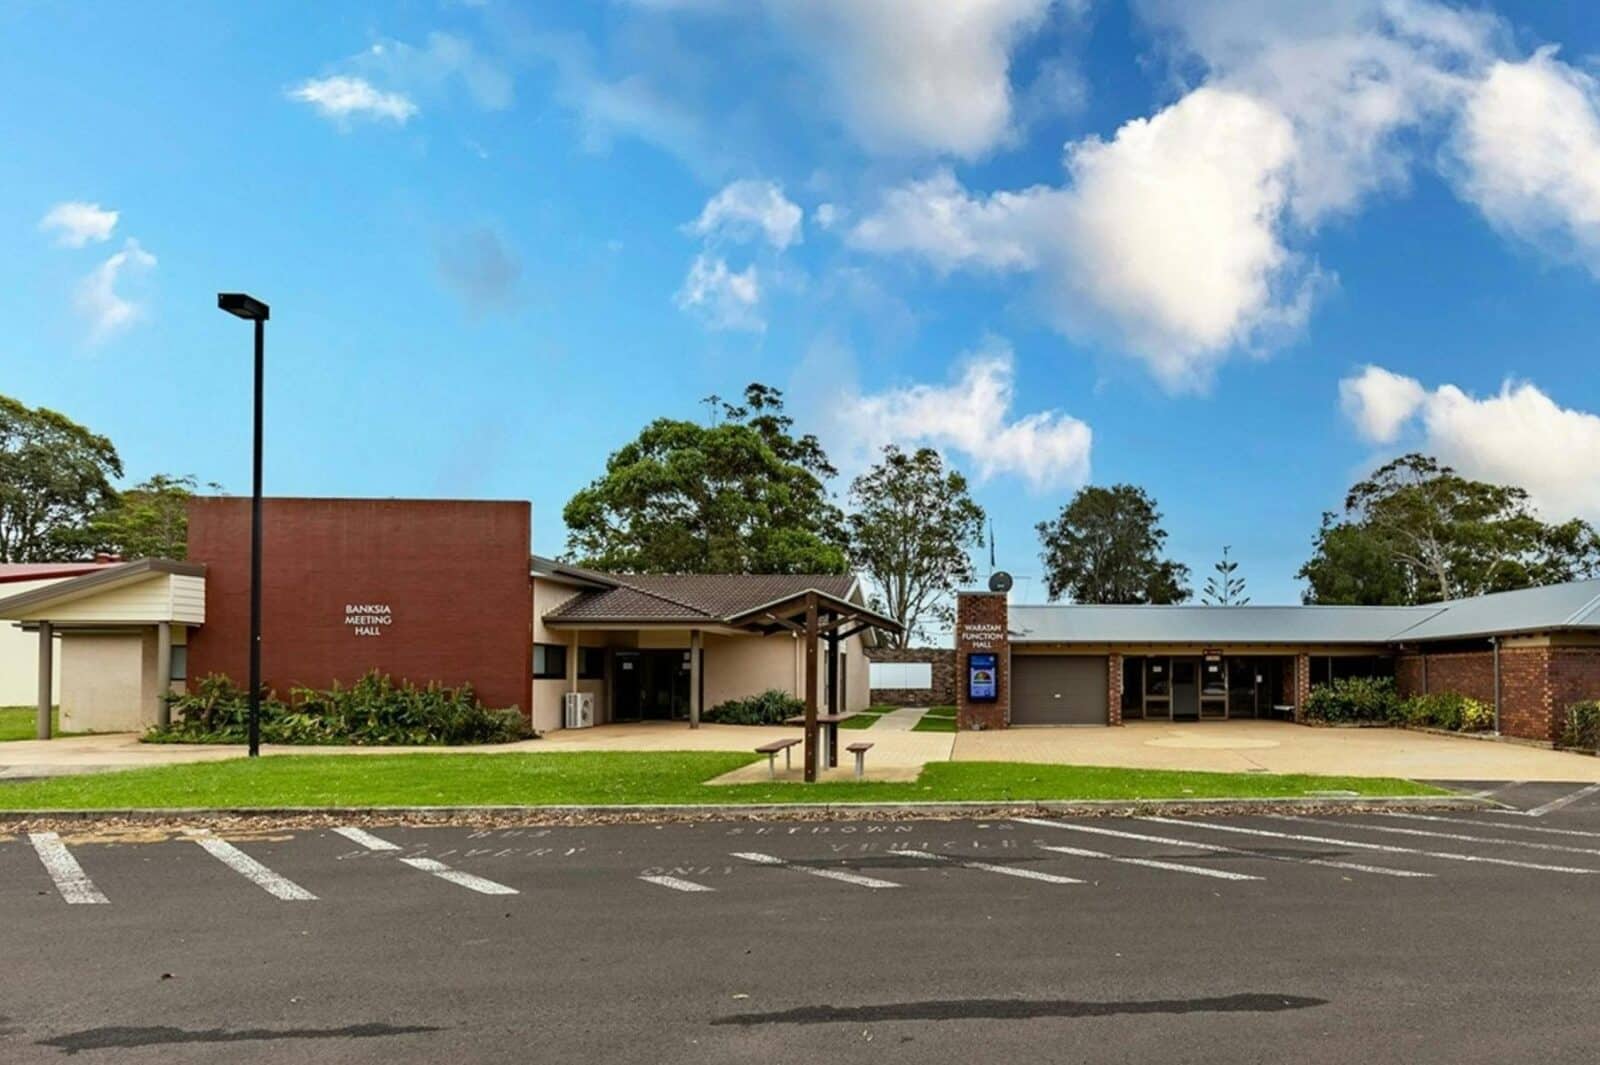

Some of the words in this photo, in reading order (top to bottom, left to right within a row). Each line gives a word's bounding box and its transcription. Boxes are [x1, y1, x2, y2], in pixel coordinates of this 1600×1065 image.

[346, 604, 392, 614] BANKSIA
[344, 615, 392, 625] MEETING
[355, 626, 380, 636] HALL
